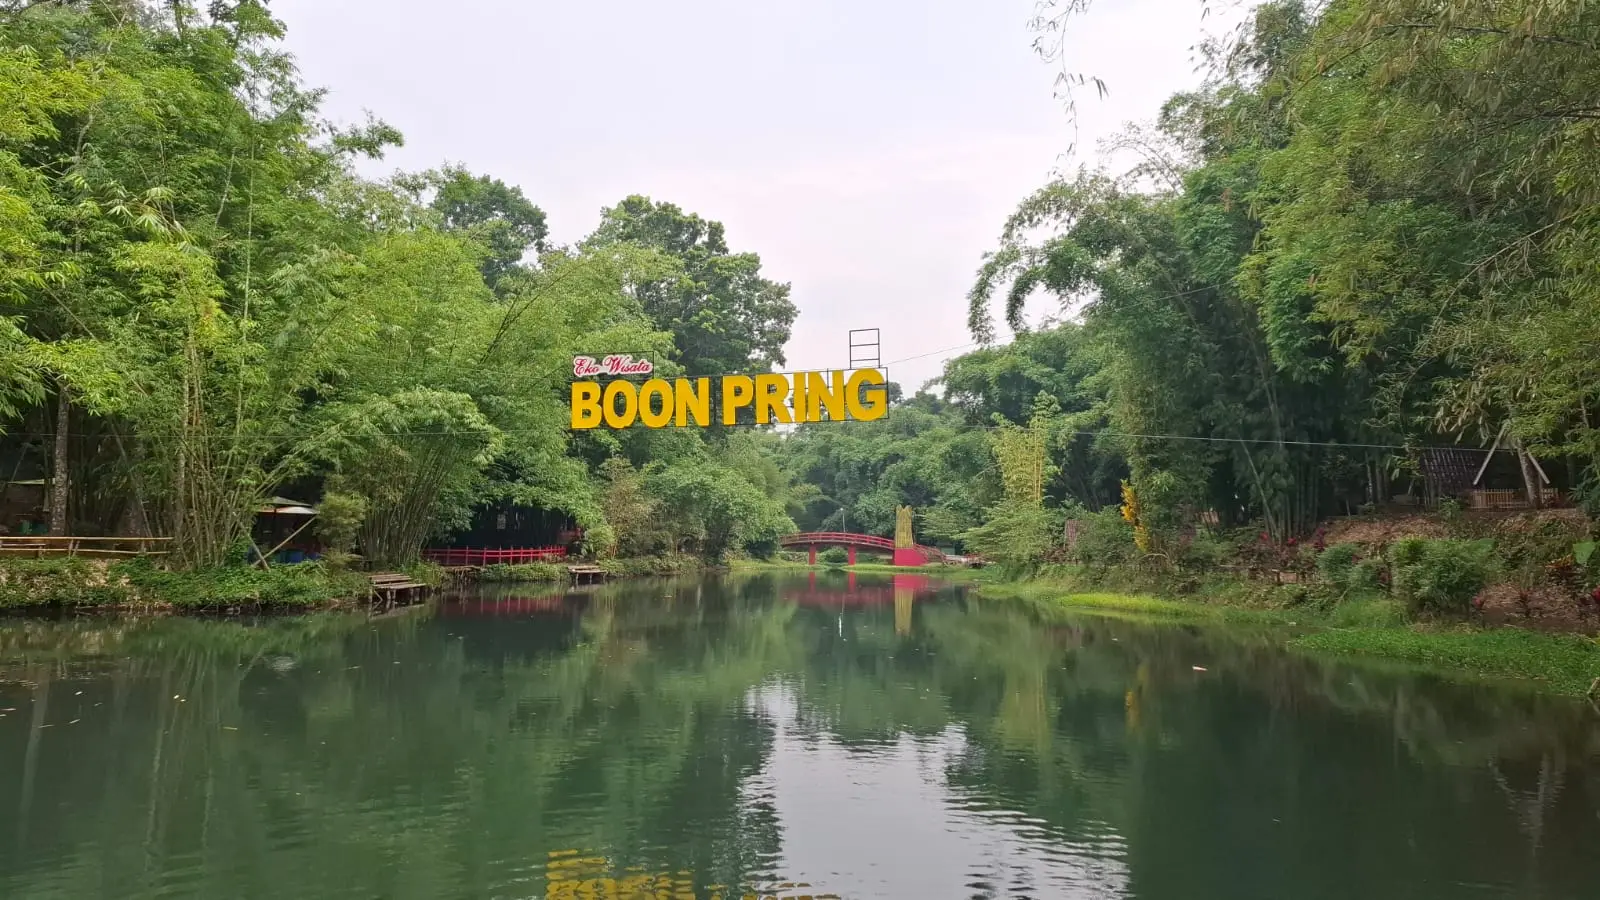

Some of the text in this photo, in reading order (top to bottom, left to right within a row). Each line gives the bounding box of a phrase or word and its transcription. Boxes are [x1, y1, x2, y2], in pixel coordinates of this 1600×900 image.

[574, 356, 652, 376] Eko Wisata
[571, 367, 888, 430] BOON PRING
